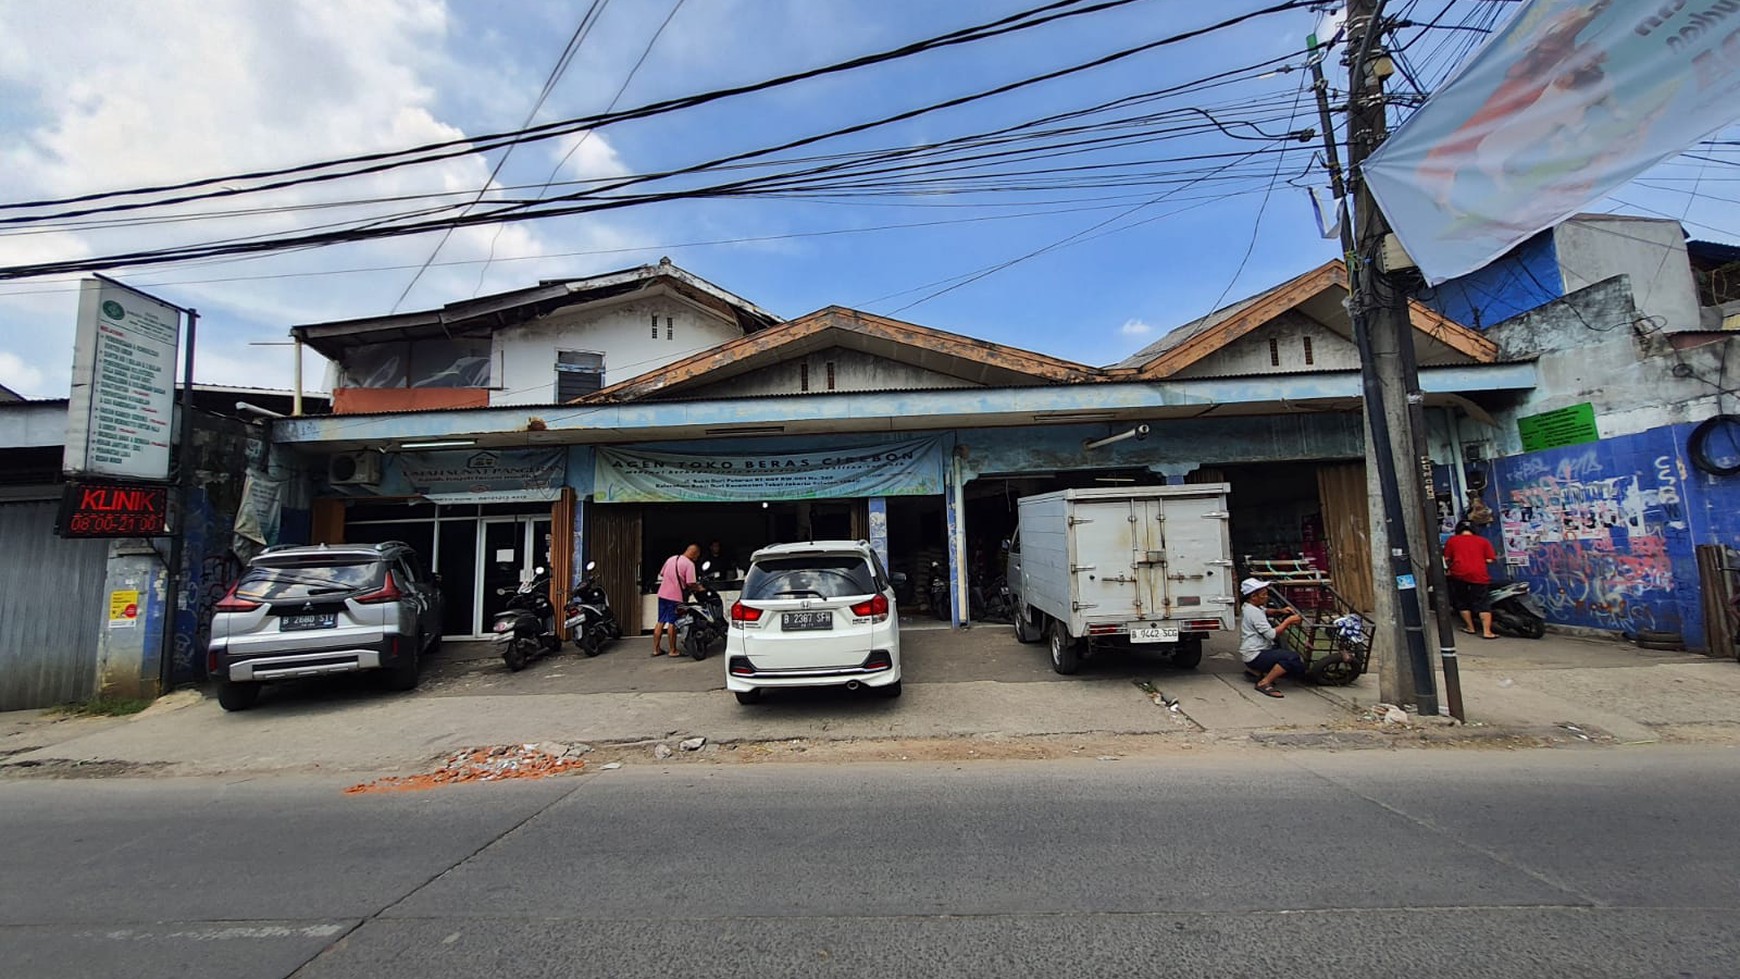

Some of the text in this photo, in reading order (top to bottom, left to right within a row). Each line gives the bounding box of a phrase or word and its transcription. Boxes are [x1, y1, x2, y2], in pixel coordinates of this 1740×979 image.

[611, 460, 665, 469] AGEN
[679, 460, 734, 469] TOKO
[745, 458, 810, 469] BERAS
[81, 489, 154, 512] KLINIK
[783, 614, 790, 624] B
[1131, 630, 1137, 638] B
